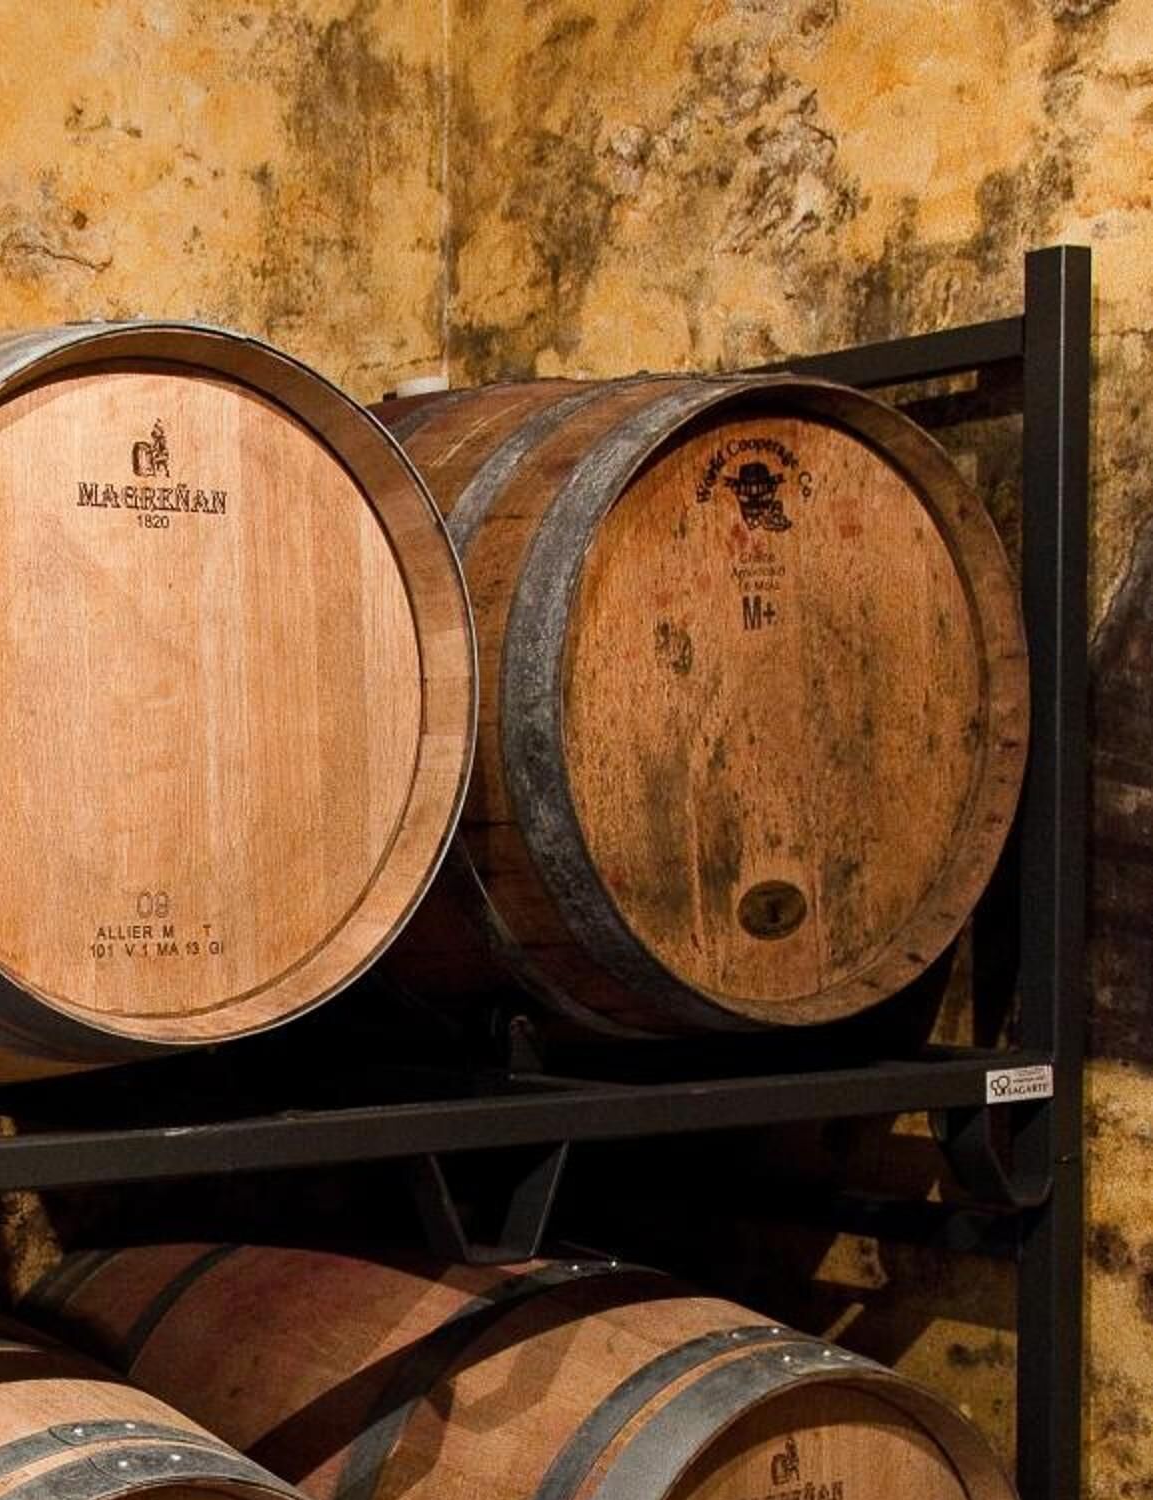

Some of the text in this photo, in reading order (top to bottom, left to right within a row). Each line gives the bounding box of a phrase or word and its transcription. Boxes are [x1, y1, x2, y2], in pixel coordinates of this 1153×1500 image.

[76, 481, 229, 515] MAGREÑAN
[136, 515, 170, 529] 1820
[742, 595, 776, 631] M+
[96, 923, 212, 940] ALLIER M T
[124, 943, 136, 957] V
[157, 942, 179, 957] MA
